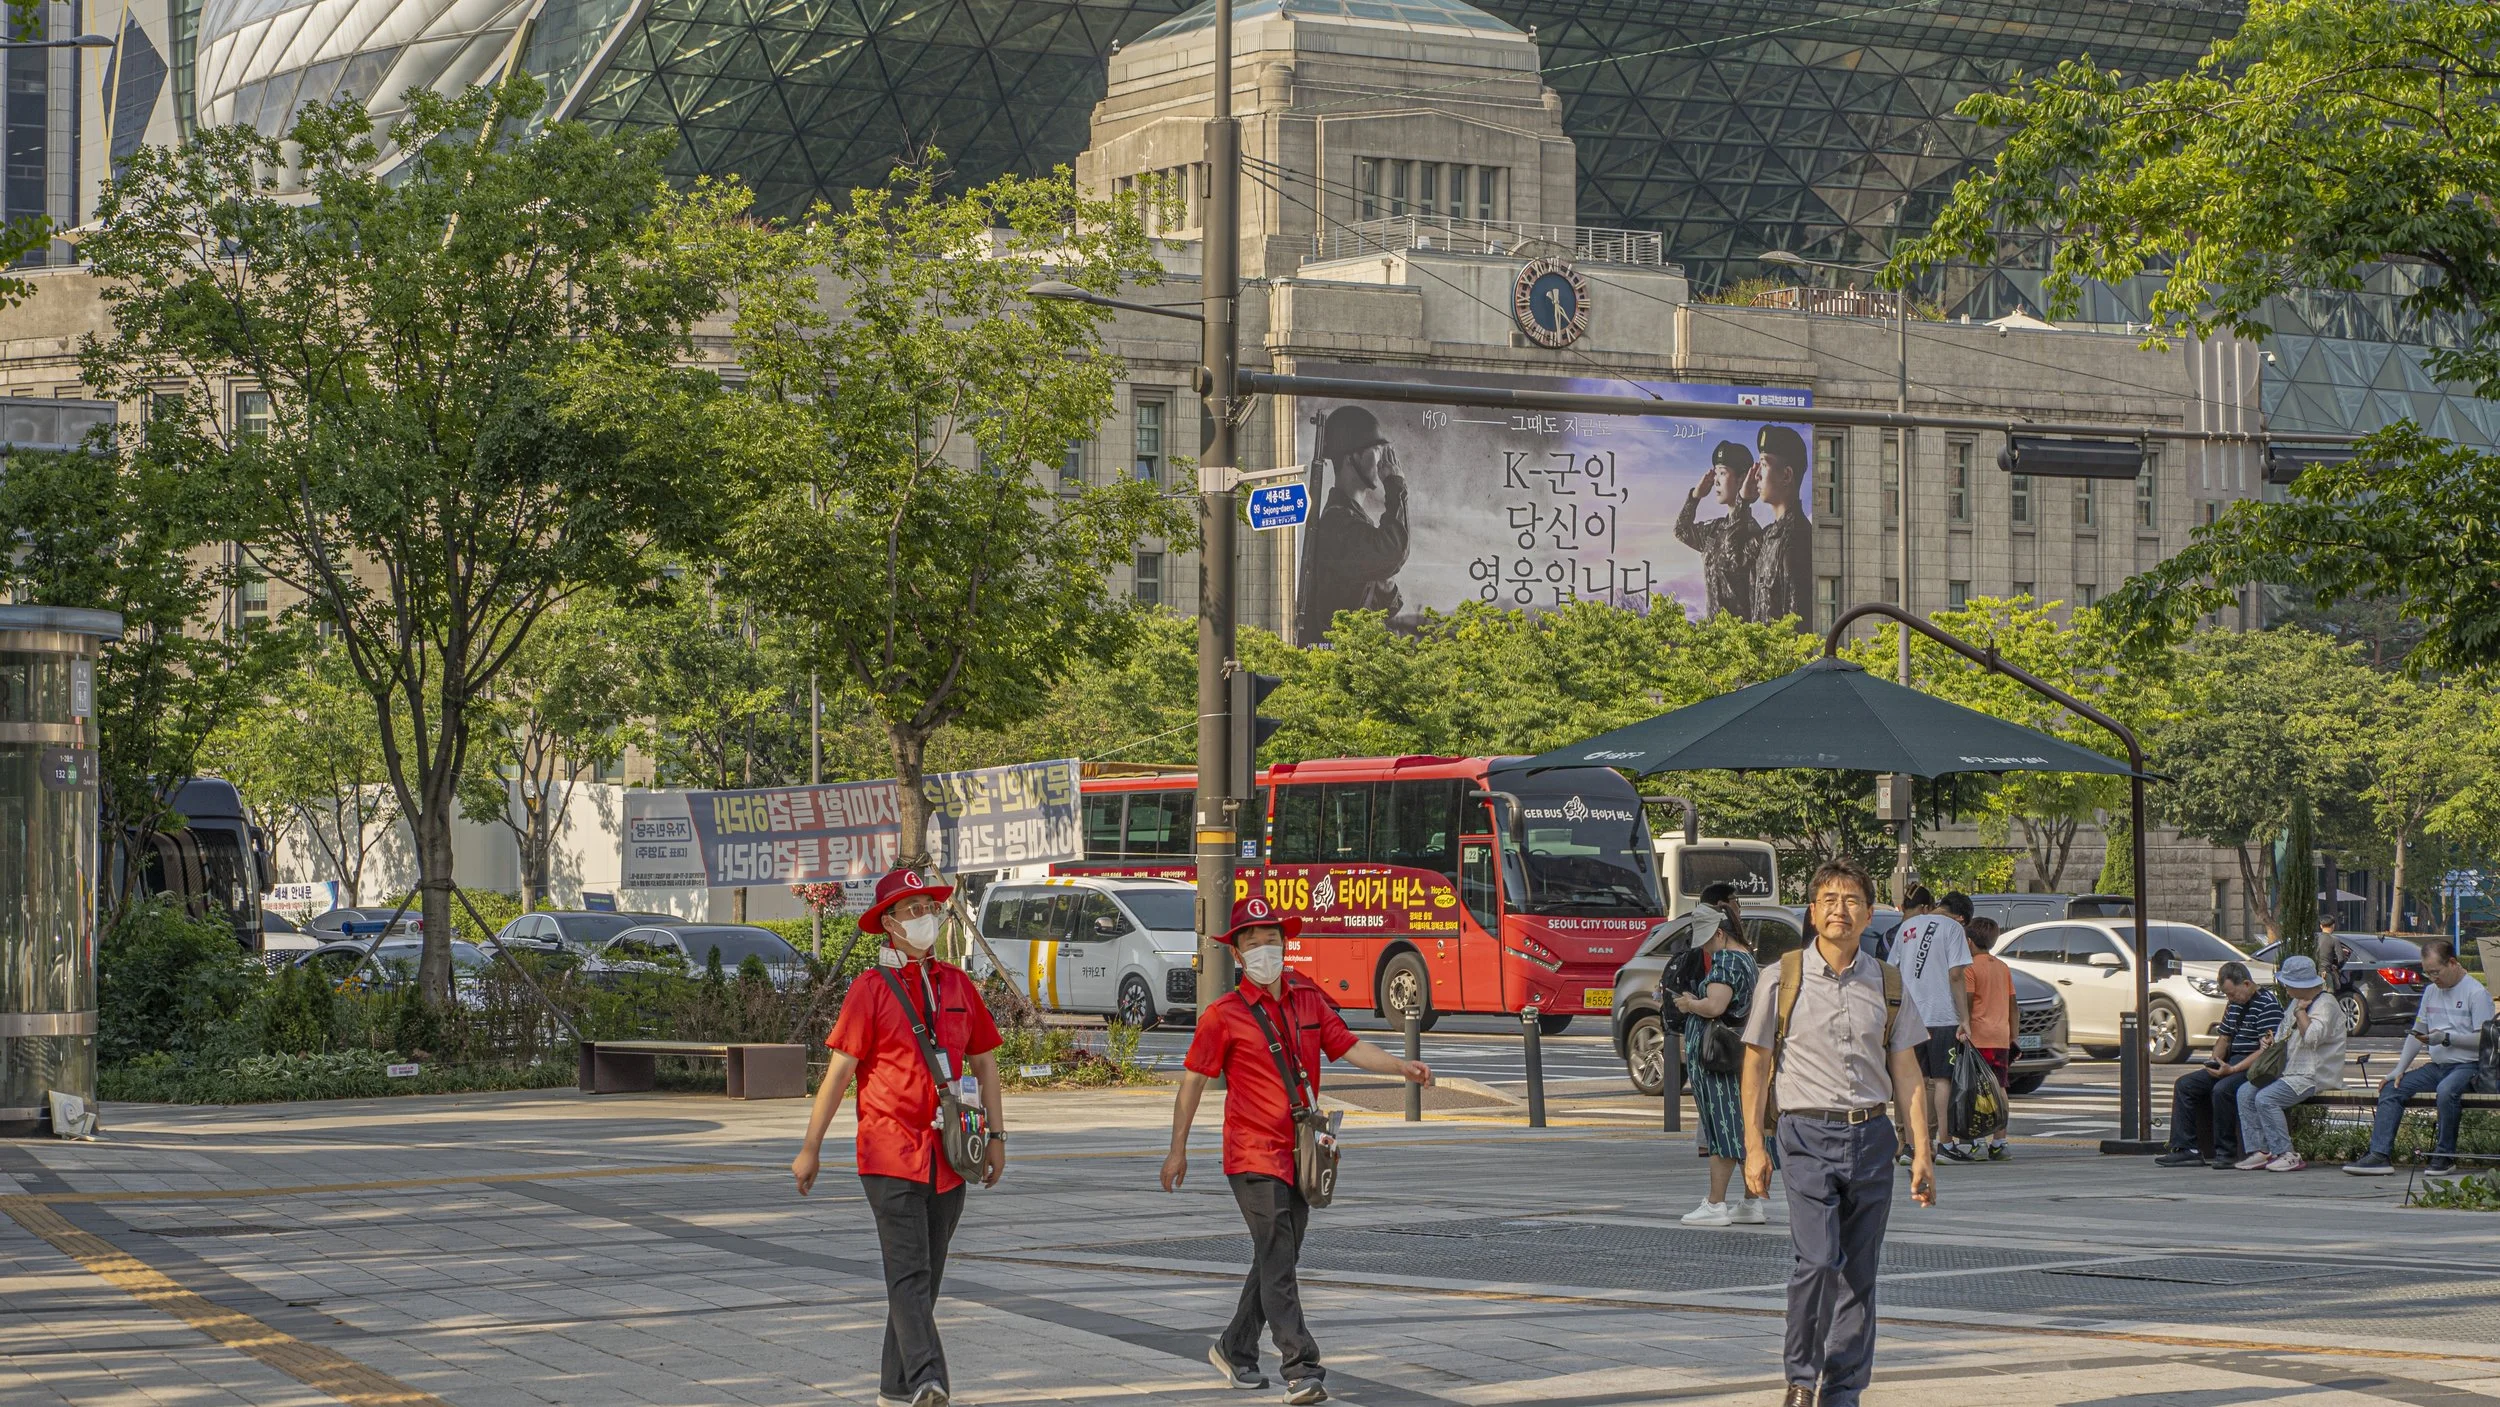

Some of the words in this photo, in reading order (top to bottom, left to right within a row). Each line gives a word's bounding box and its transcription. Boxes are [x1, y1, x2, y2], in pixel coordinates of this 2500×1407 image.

[1760, 395, 1797, 406] 호국보훈의
[1797, 396, 1806, 407] 달
[1422, 410, 1448, 431] 1950
[1510, 414, 1560, 435] 그때도
[1563, 416, 1612, 437] 지금도
[1672, 423, 1708, 443] 2024
[1502, 450, 1629, 504] K-군인,
[1265, 488, 1292, 504] 세종대로
[1296, 498, 1304, 509] 95
[1262, 504, 1295, 516] Sejong-daero
[1506, 501, 1616, 554] 당신이
[1469, 554, 1658, 608] 영웅입니다
[55, 769, 66, 779] 132
[1524, 808, 1543, 819] GER
[1544, 808, 1562, 819] BUS
[1591, 809, 1617, 821] 타이거
[1617, 810, 1634, 822] 버스
[291, 885, 312, 900] 안내문
[1264, 878, 1310, 911] BUS
[1338, 877, 1388, 910] 타이거
[1392, 876, 1426, 910] 버스
[1343, 915, 1368, 927] TIGER
[1368, 915, 1384, 927] BUS
[1548, 919, 1579, 929] SEOUL
[1580, 919, 1601, 930] CITY
[1602, 919, 1627, 930] TOUR
[1629, 920, 1647, 930] BUS
[1288, 940, 1301, 951] BUS
[1588, 946, 1614, 954] MAN
[1082, 966, 1101, 978] 카카오
[1101, 967, 1106, 977] T
[1592, 996, 1613, 1007] 5522
